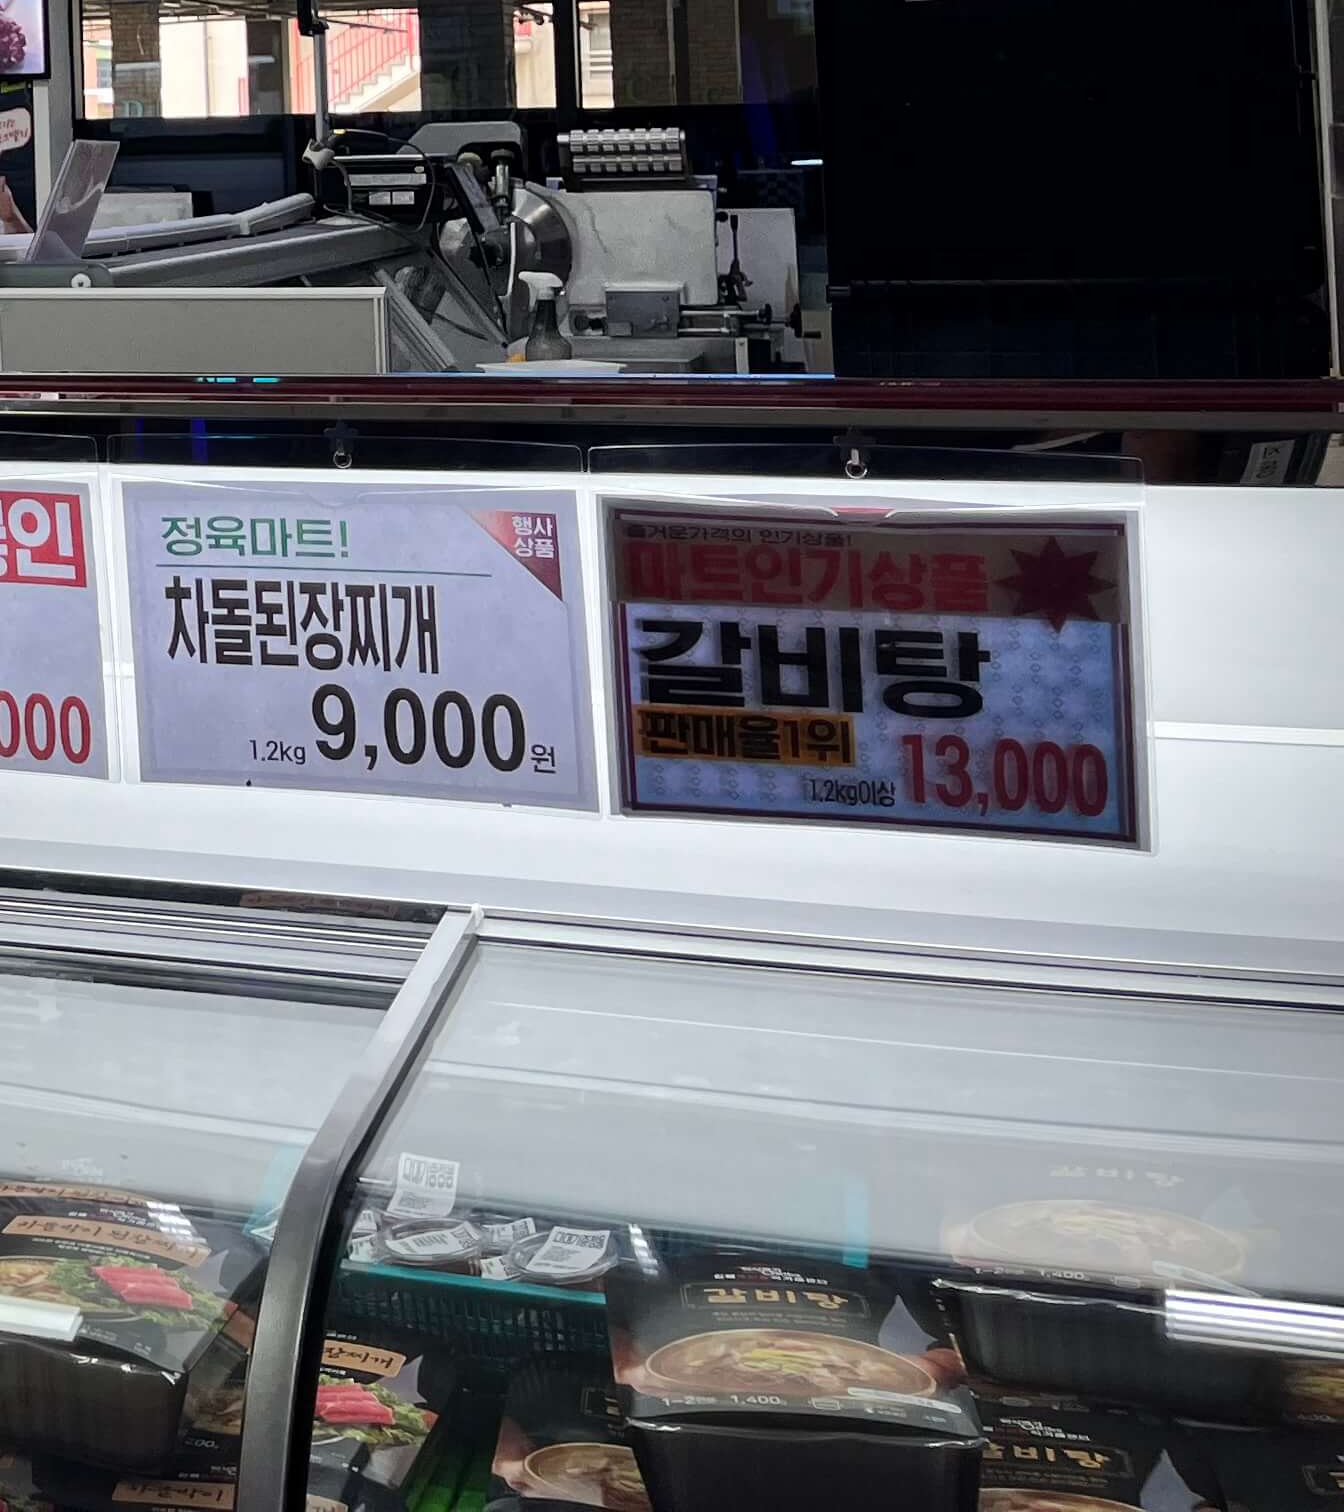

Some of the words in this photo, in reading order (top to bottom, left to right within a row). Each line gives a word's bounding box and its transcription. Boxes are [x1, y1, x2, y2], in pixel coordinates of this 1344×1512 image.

[161, 515, 349, 558] 정육마트!
[512, 514, 553, 536] 행사
[513, 537, 555, 559] 상품
[164, 575, 439, 674] 차돌된장찌개
[634, 616, 993, 720] 갈비탕
[249, 739, 306, 765] 1.2kg
[312, 683, 526, 772] 9,000
[531, 744, 557, 774] 원
[809, 777, 896, 809] 1.2kg이상
[902, 732, 1109, 817] 13,000
